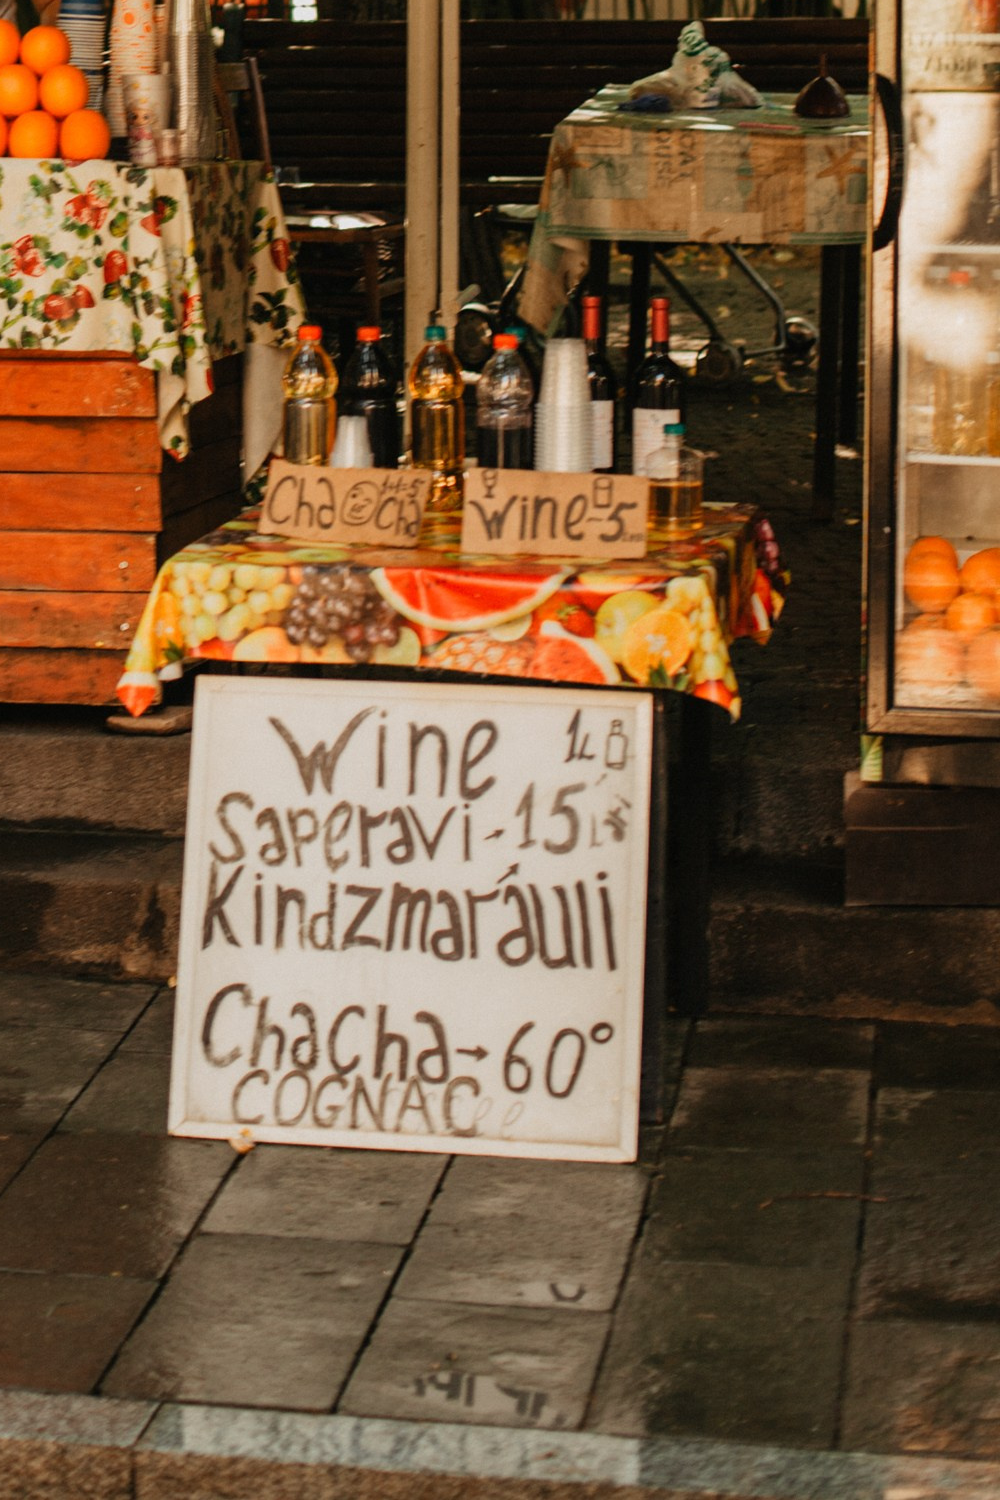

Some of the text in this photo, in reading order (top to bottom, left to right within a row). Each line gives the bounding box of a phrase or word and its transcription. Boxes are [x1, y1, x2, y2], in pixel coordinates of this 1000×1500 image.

[268, 706, 500, 799] Wine
[208, 792, 473, 871] Saperavi
[202, 863, 618, 972] Kindzmarauli
[231, 1069, 482, 1137] COGNAC
